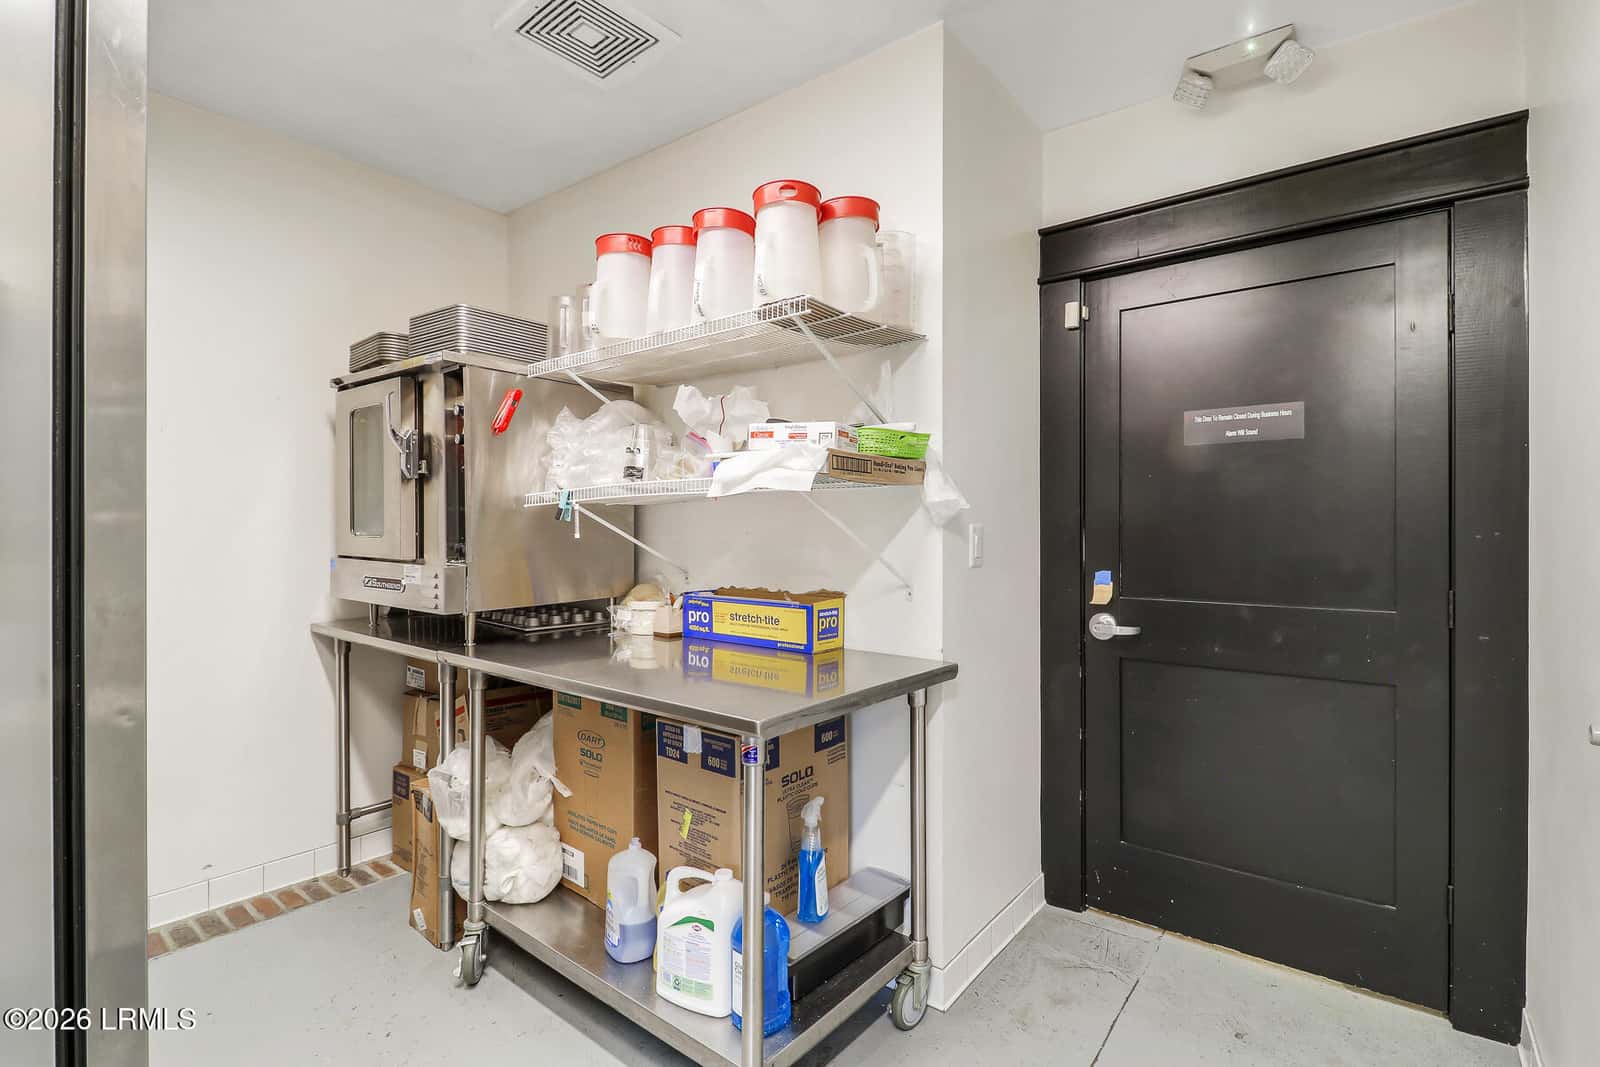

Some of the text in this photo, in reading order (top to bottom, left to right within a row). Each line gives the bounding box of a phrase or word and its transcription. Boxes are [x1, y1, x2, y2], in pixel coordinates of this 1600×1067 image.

[688, 610, 710, 624] pro
[729, 612, 780, 626] stretch-tite
[818, 616, 838, 633] pro
[581, 732, 602, 745] DART
[821, 730, 832, 743] 600
[580, 747, 603, 762] SOLO
[708, 755, 720, 769] 600
[781, 766, 814, 788] SOLO
